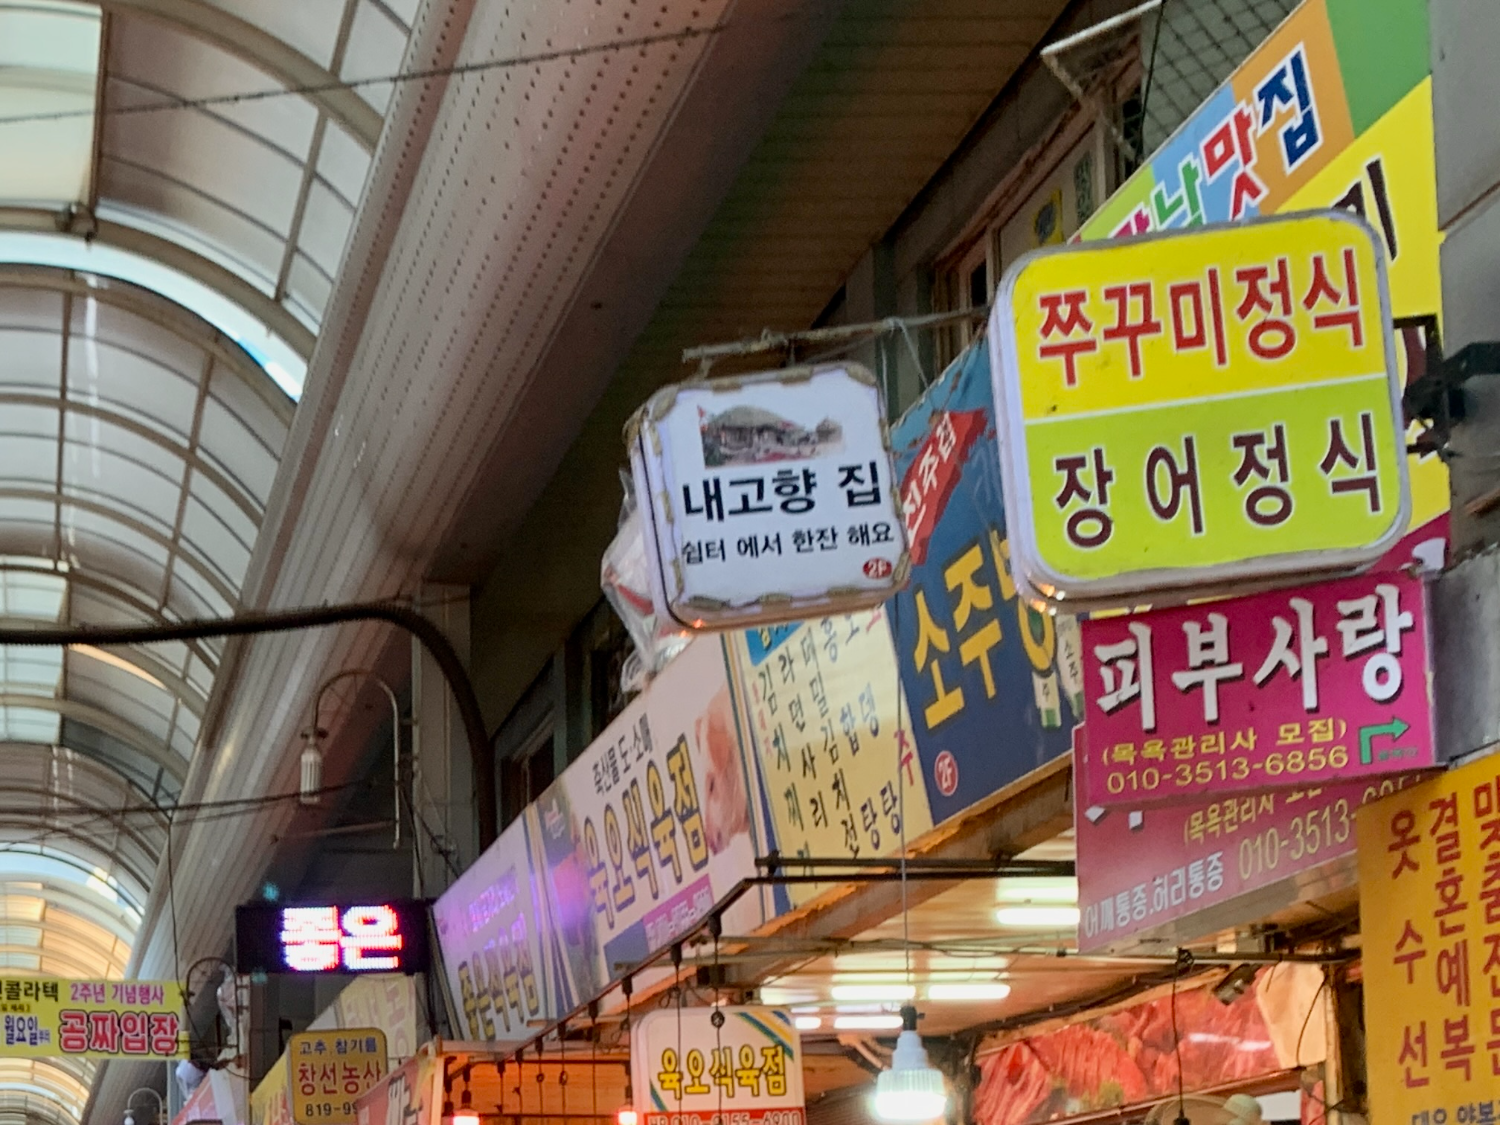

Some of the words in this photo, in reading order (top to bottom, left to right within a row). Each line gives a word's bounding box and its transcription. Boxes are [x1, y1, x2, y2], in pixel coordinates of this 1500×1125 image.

[1038, 248, 1364, 387] 쭈꾸미정식
[682, 468, 818, 522] 내고향
[837, 461, 883, 508] 집
[681, 540, 727, 565] 쉼터
[737, 533, 783, 559] 에서
[792, 526, 838, 553] 한잔
[848, 521, 895, 546] 해요
[1094, 583, 1415, 732] 피부사랑
[1102, 729, 1258, 768] (목욕관리사
[1276, 716, 1348, 745] 모집)
[1106, 745, 1350, 796] 010-3513-6856
[583, 731, 710, 930] 육오식육점
[70, 982, 107, 1005] 2주년
[111, 982, 166, 1006] 기념행사
[58, 1008, 180, 1057] 공짜입장
[298, 1060, 382, 1097] 창선농산
[656, 1044, 788, 1101] 육오식육점
